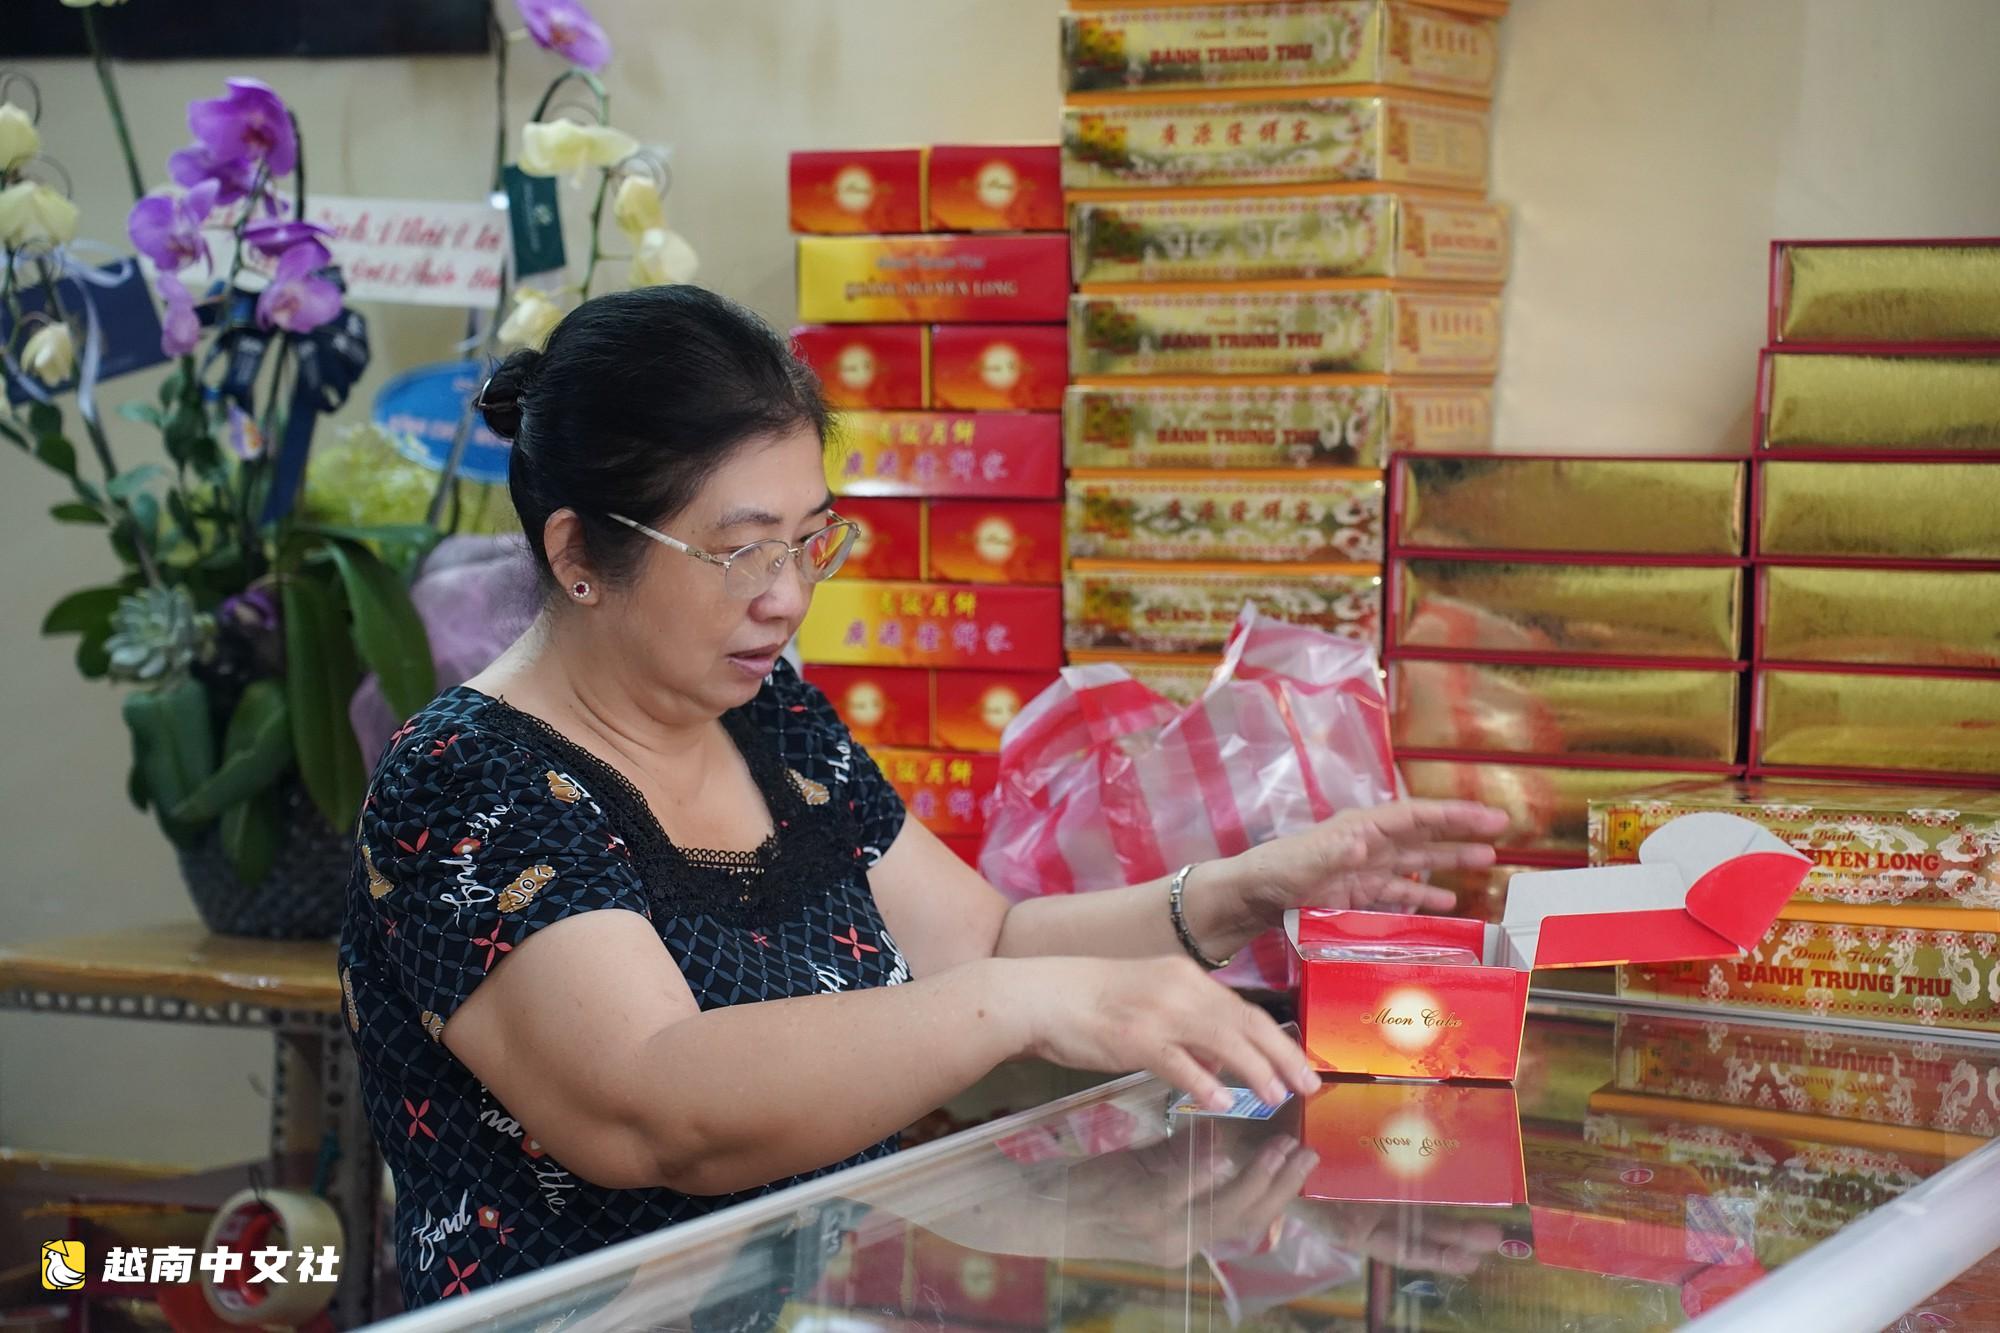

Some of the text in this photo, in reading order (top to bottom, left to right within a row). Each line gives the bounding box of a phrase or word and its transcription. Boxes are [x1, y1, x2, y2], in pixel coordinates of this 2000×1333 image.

[1876, 852, 1940, 872] LONG
[1737, 961, 1953, 998] BÁNH TRUNG THU
[1360, 1006, 1463, 1029] Moon Cake
